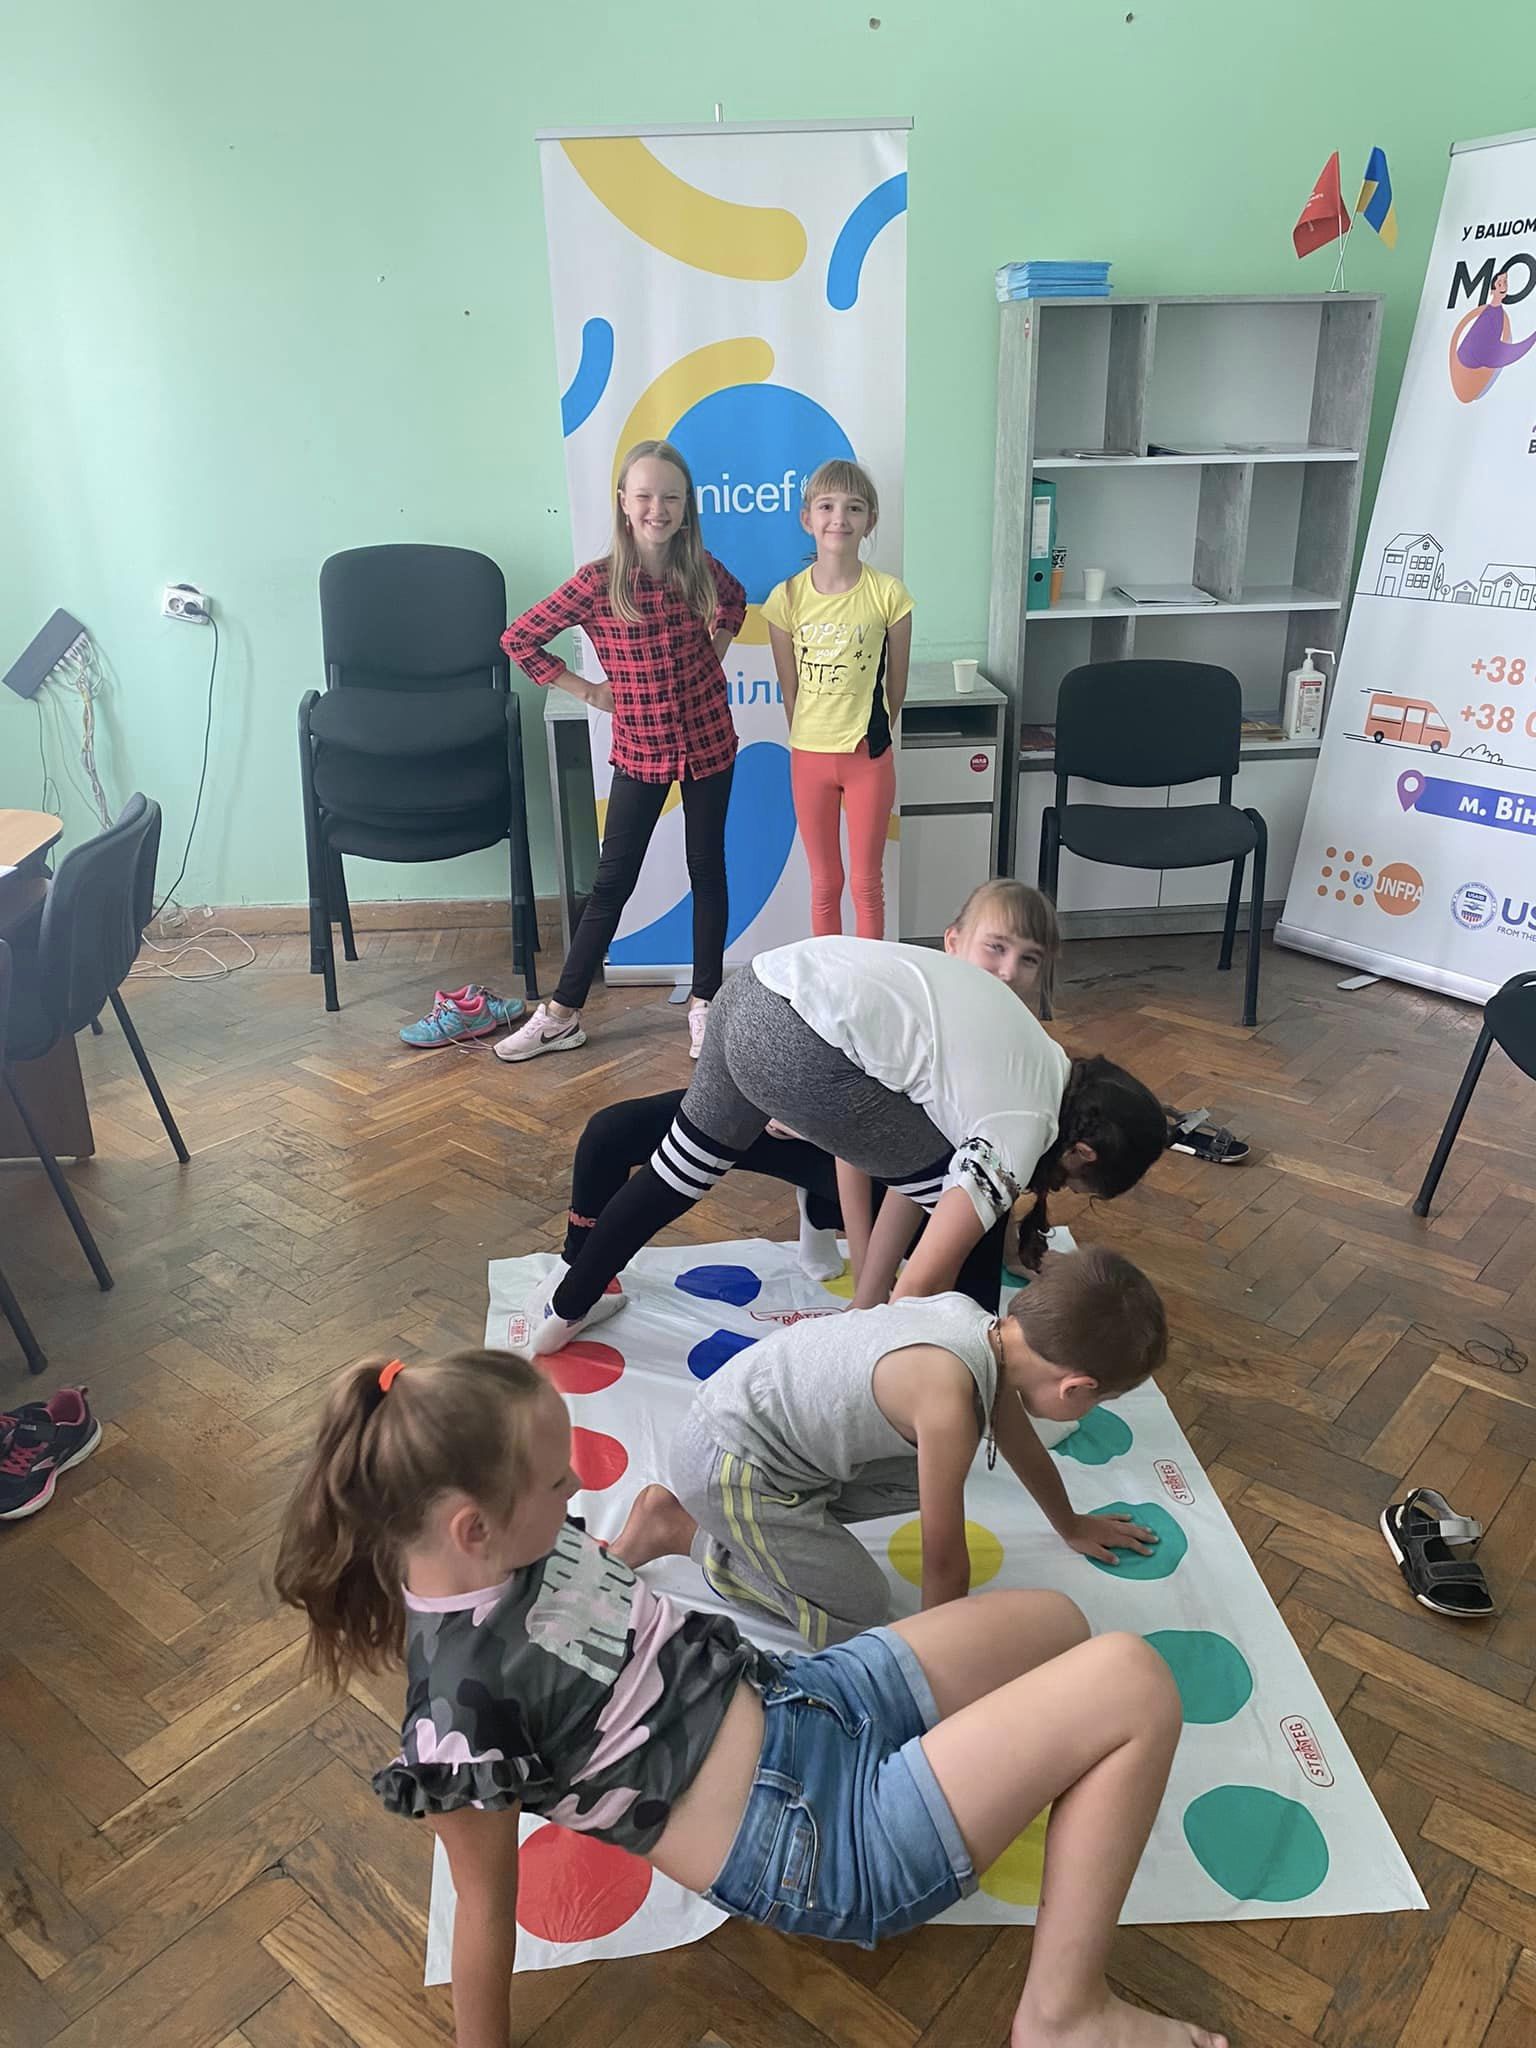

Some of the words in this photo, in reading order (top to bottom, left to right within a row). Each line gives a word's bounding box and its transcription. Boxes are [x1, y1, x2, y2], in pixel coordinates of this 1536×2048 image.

[695, 469, 797, 514] nicef
[1470, 655, 1527, 686] +38
[1460, 703, 1516, 734] +38
[1374, 876, 1424, 903] UNFPA
[1496, 925, 1520, 938] FROM
